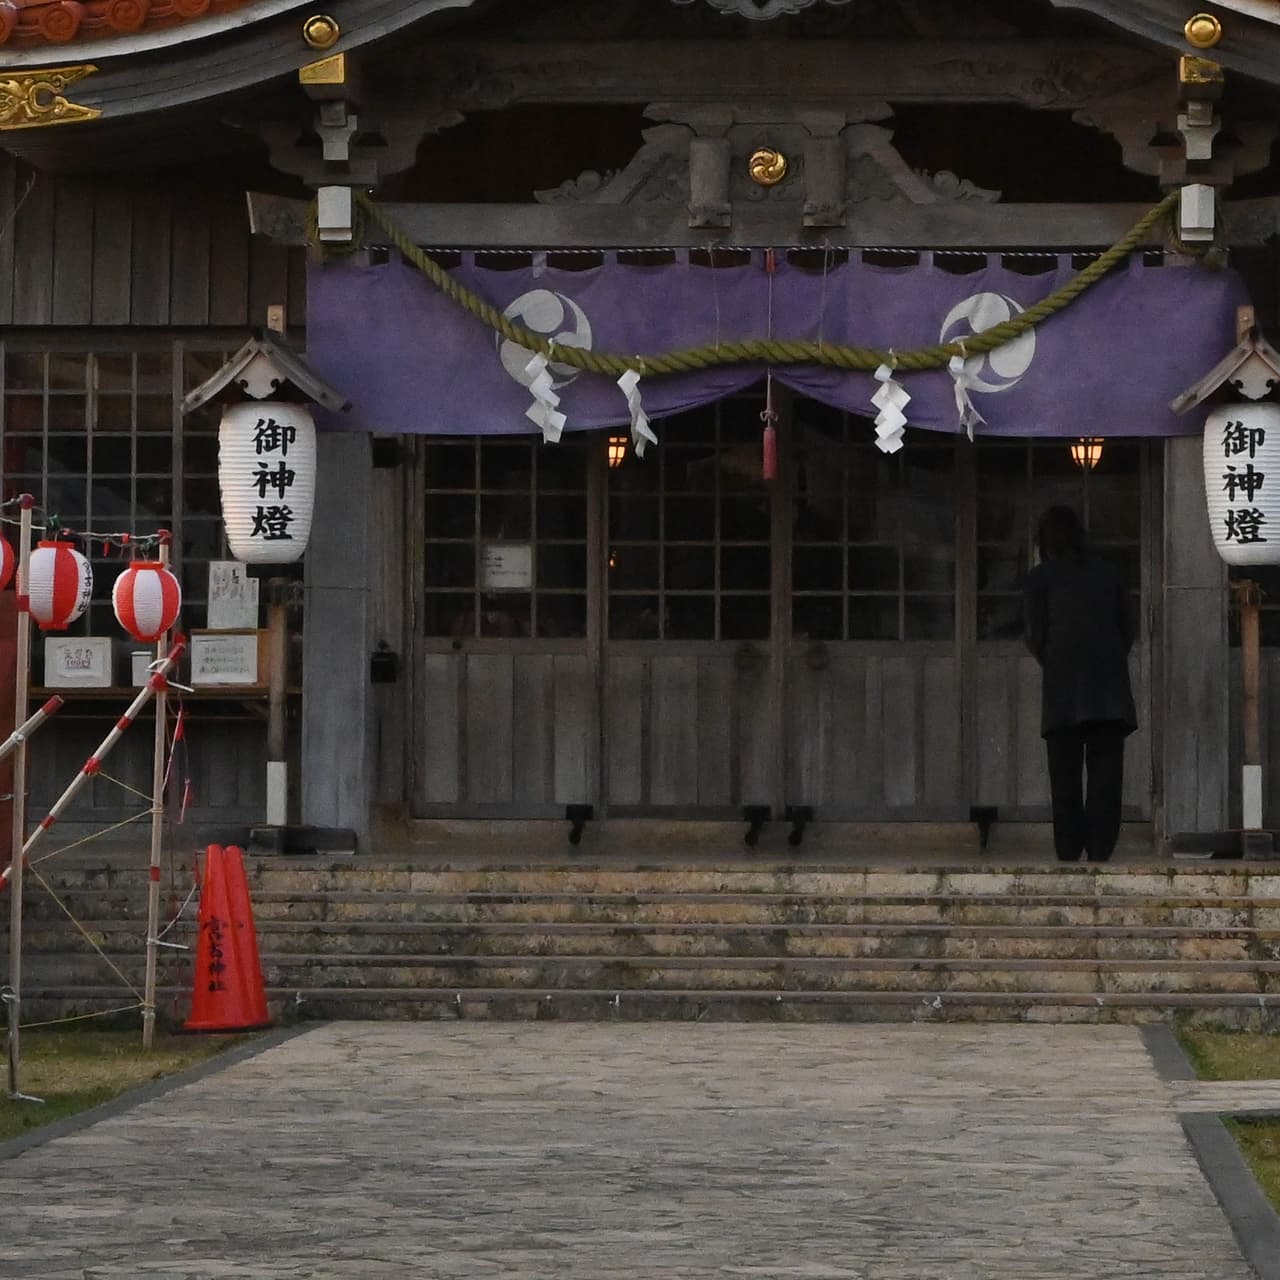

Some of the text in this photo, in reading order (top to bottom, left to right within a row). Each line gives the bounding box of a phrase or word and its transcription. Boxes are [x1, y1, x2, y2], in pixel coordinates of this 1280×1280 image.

[250, 418, 297, 540] 御神燈
[1220, 420, 1268, 545] 御神燈
